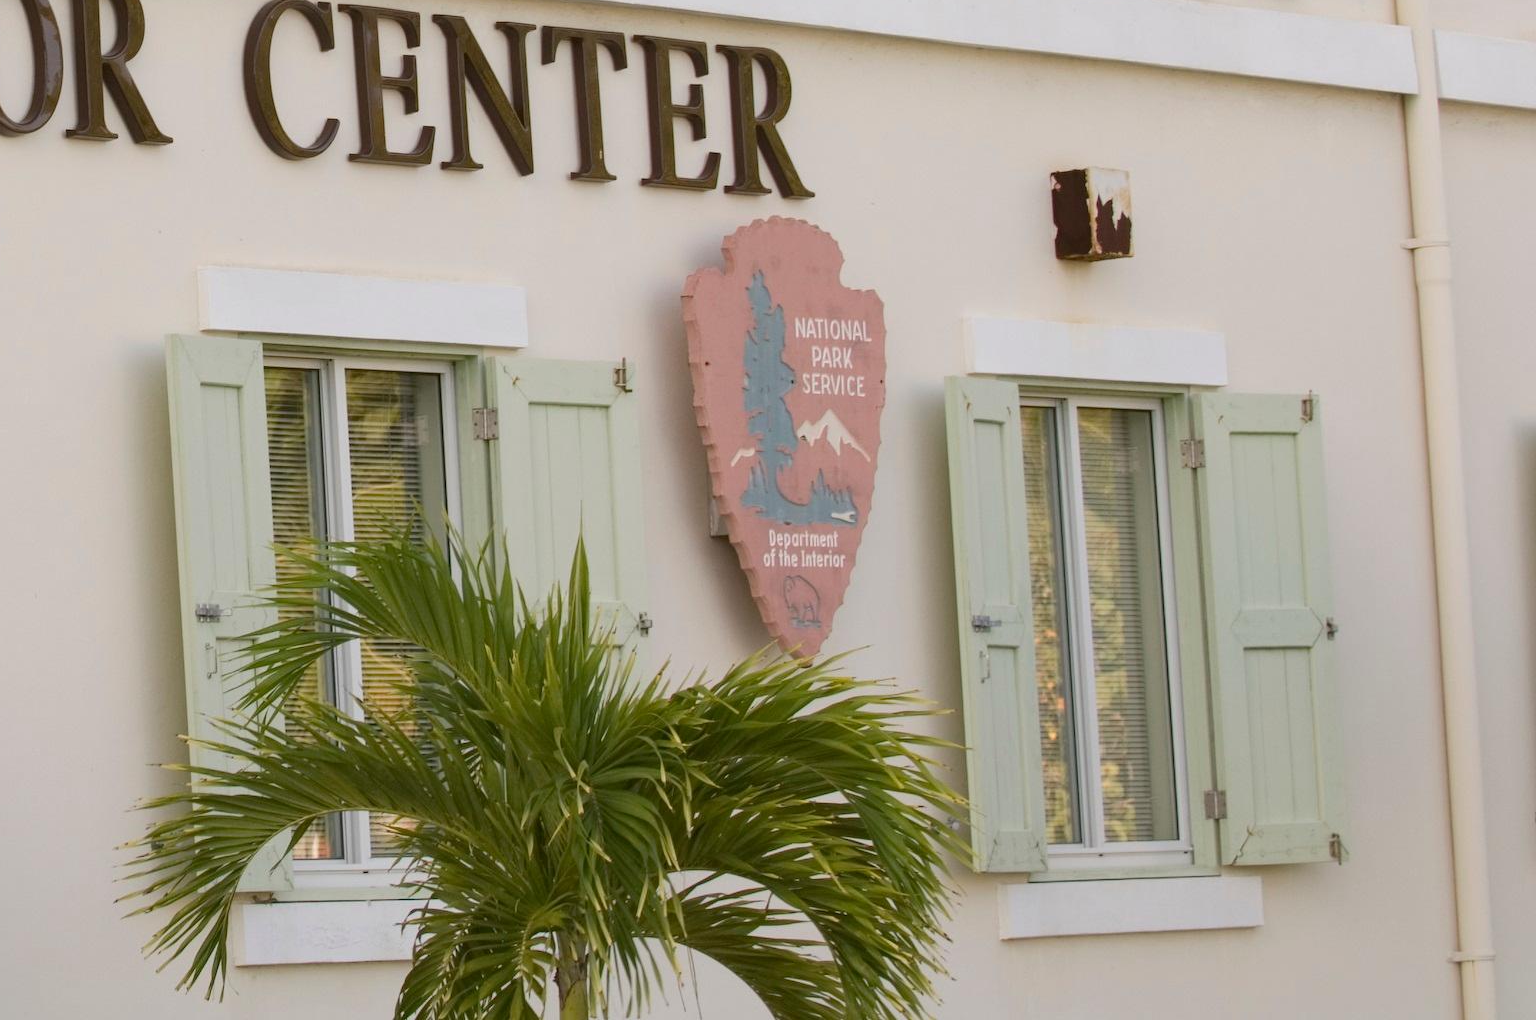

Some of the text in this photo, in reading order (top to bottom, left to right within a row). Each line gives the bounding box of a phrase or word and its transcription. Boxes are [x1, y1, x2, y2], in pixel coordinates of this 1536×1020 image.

[794, 317, 873, 342] NATIONAL
[811, 345, 853, 369] PARK
[802, 372, 866, 398] SERVICE
[768, 528, 839, 549] Department
[763, 548, 846, 568] of the Interior
